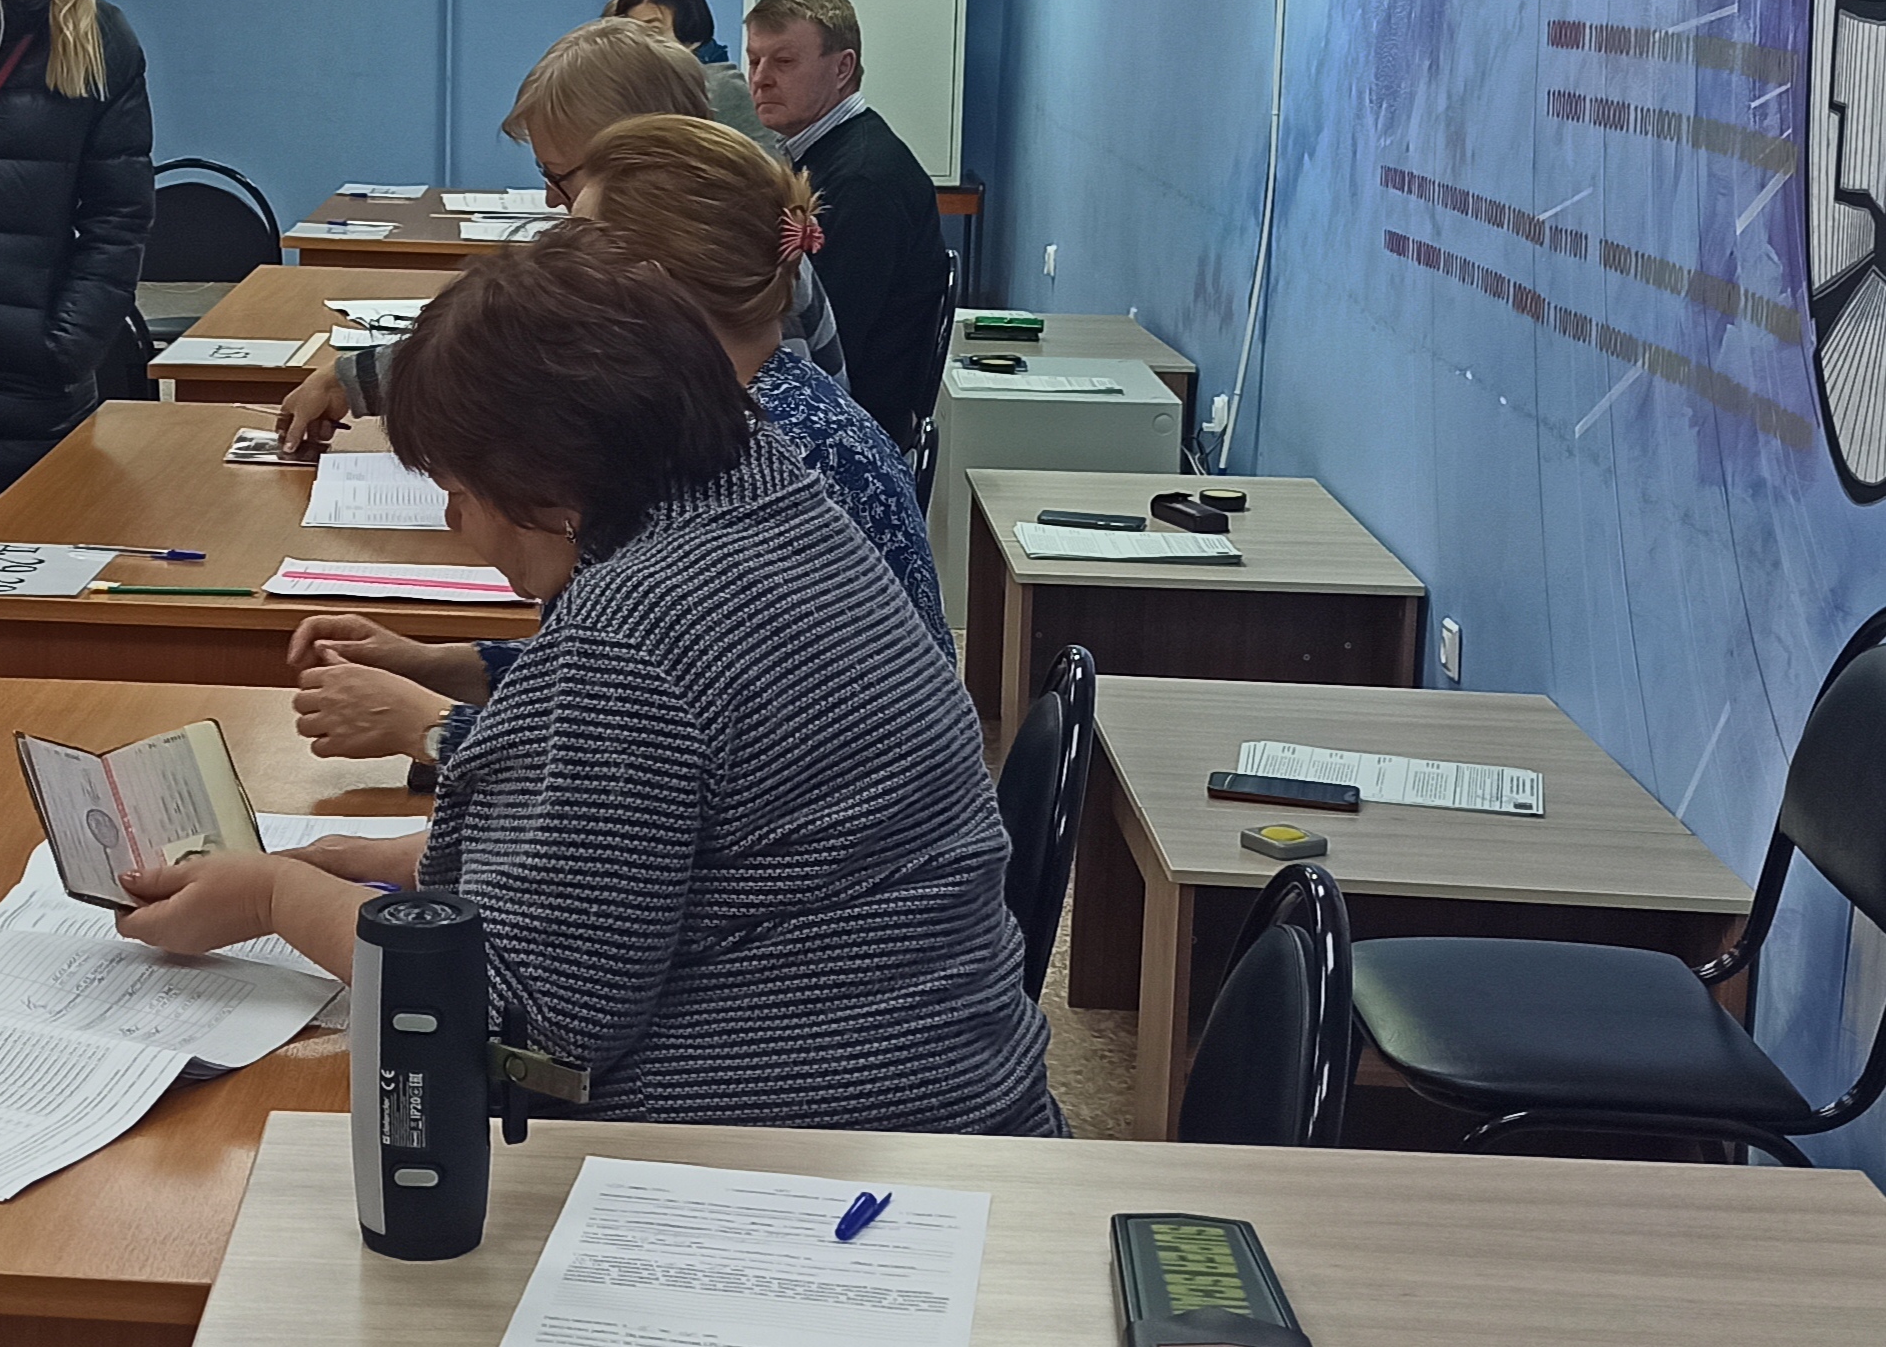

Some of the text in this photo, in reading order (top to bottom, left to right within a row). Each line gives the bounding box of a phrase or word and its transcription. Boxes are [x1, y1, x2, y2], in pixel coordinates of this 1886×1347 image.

[1547, 89, 1587, 124] 11010001
[1549, 224, 1589, 263] 10111011
[410, 1096, 422, 1119] IP20
[1150, 1223, 1239, 1274] SUPER
